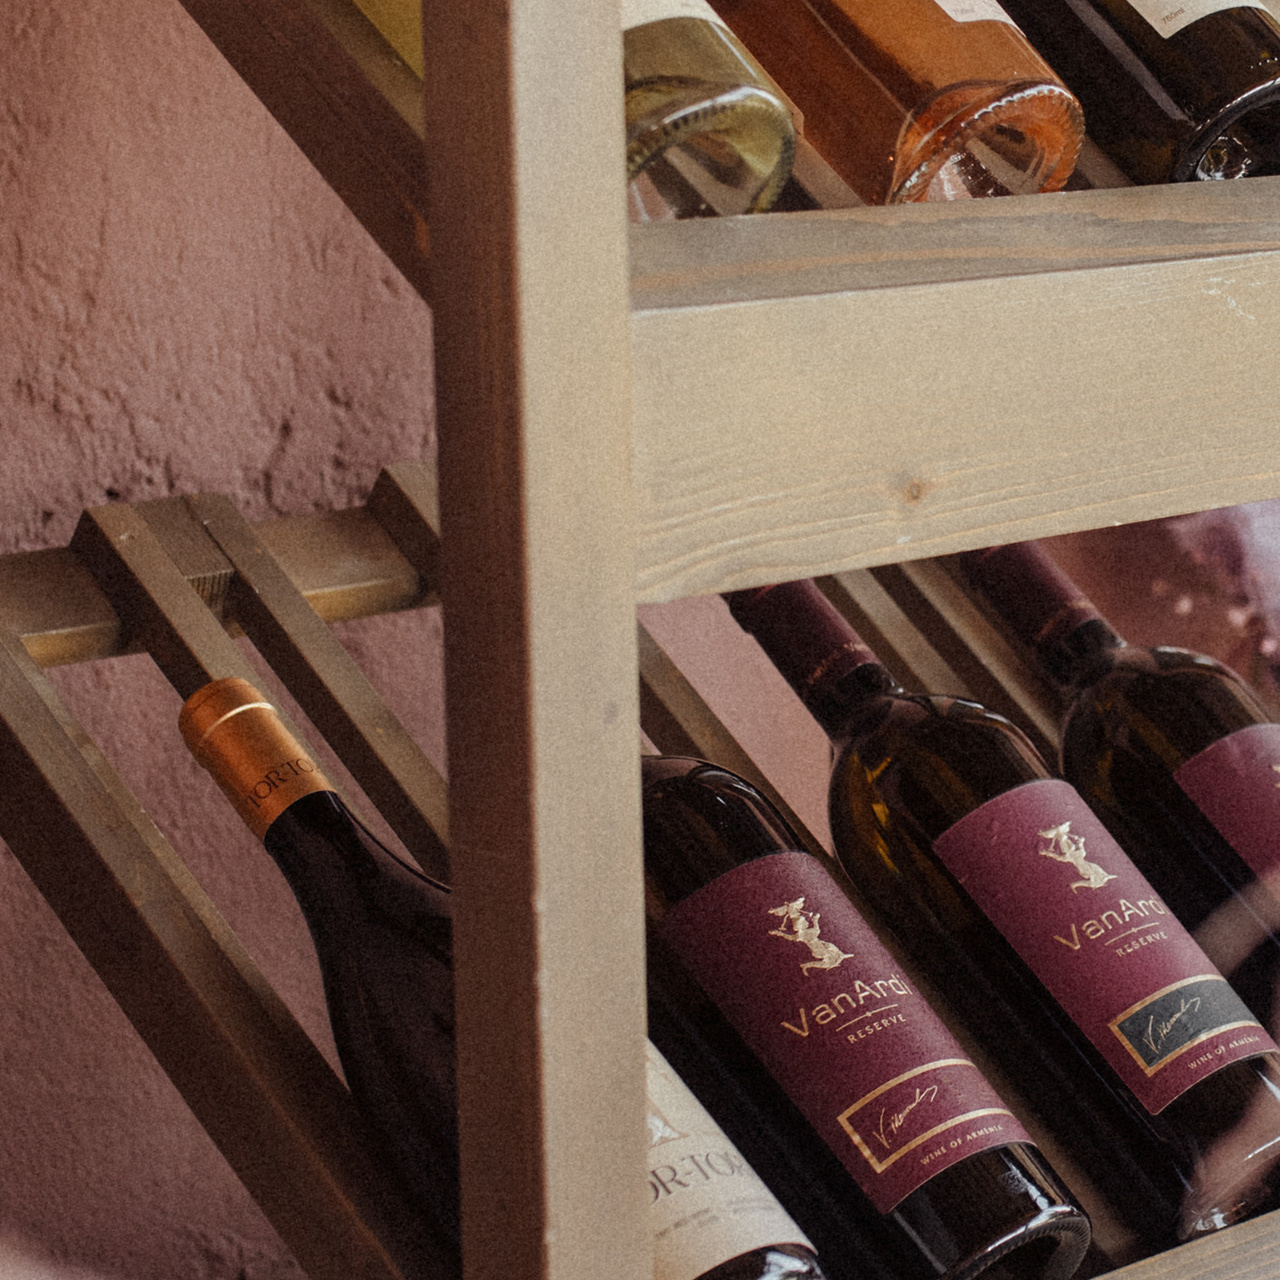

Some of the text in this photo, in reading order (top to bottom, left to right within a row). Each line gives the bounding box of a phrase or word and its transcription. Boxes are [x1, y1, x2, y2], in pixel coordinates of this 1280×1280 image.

[1115, 931, 1168, 958] RESERVE
[780, 973, 914, 1038] VanArdi
[846, 1013, 907, 1045] RESERVE
[1187, 1052, 1213, 1070] WINE
[919, 1145, 948, 1166] WINE
[965, 1124, 1004, 1142] ARMENIA
